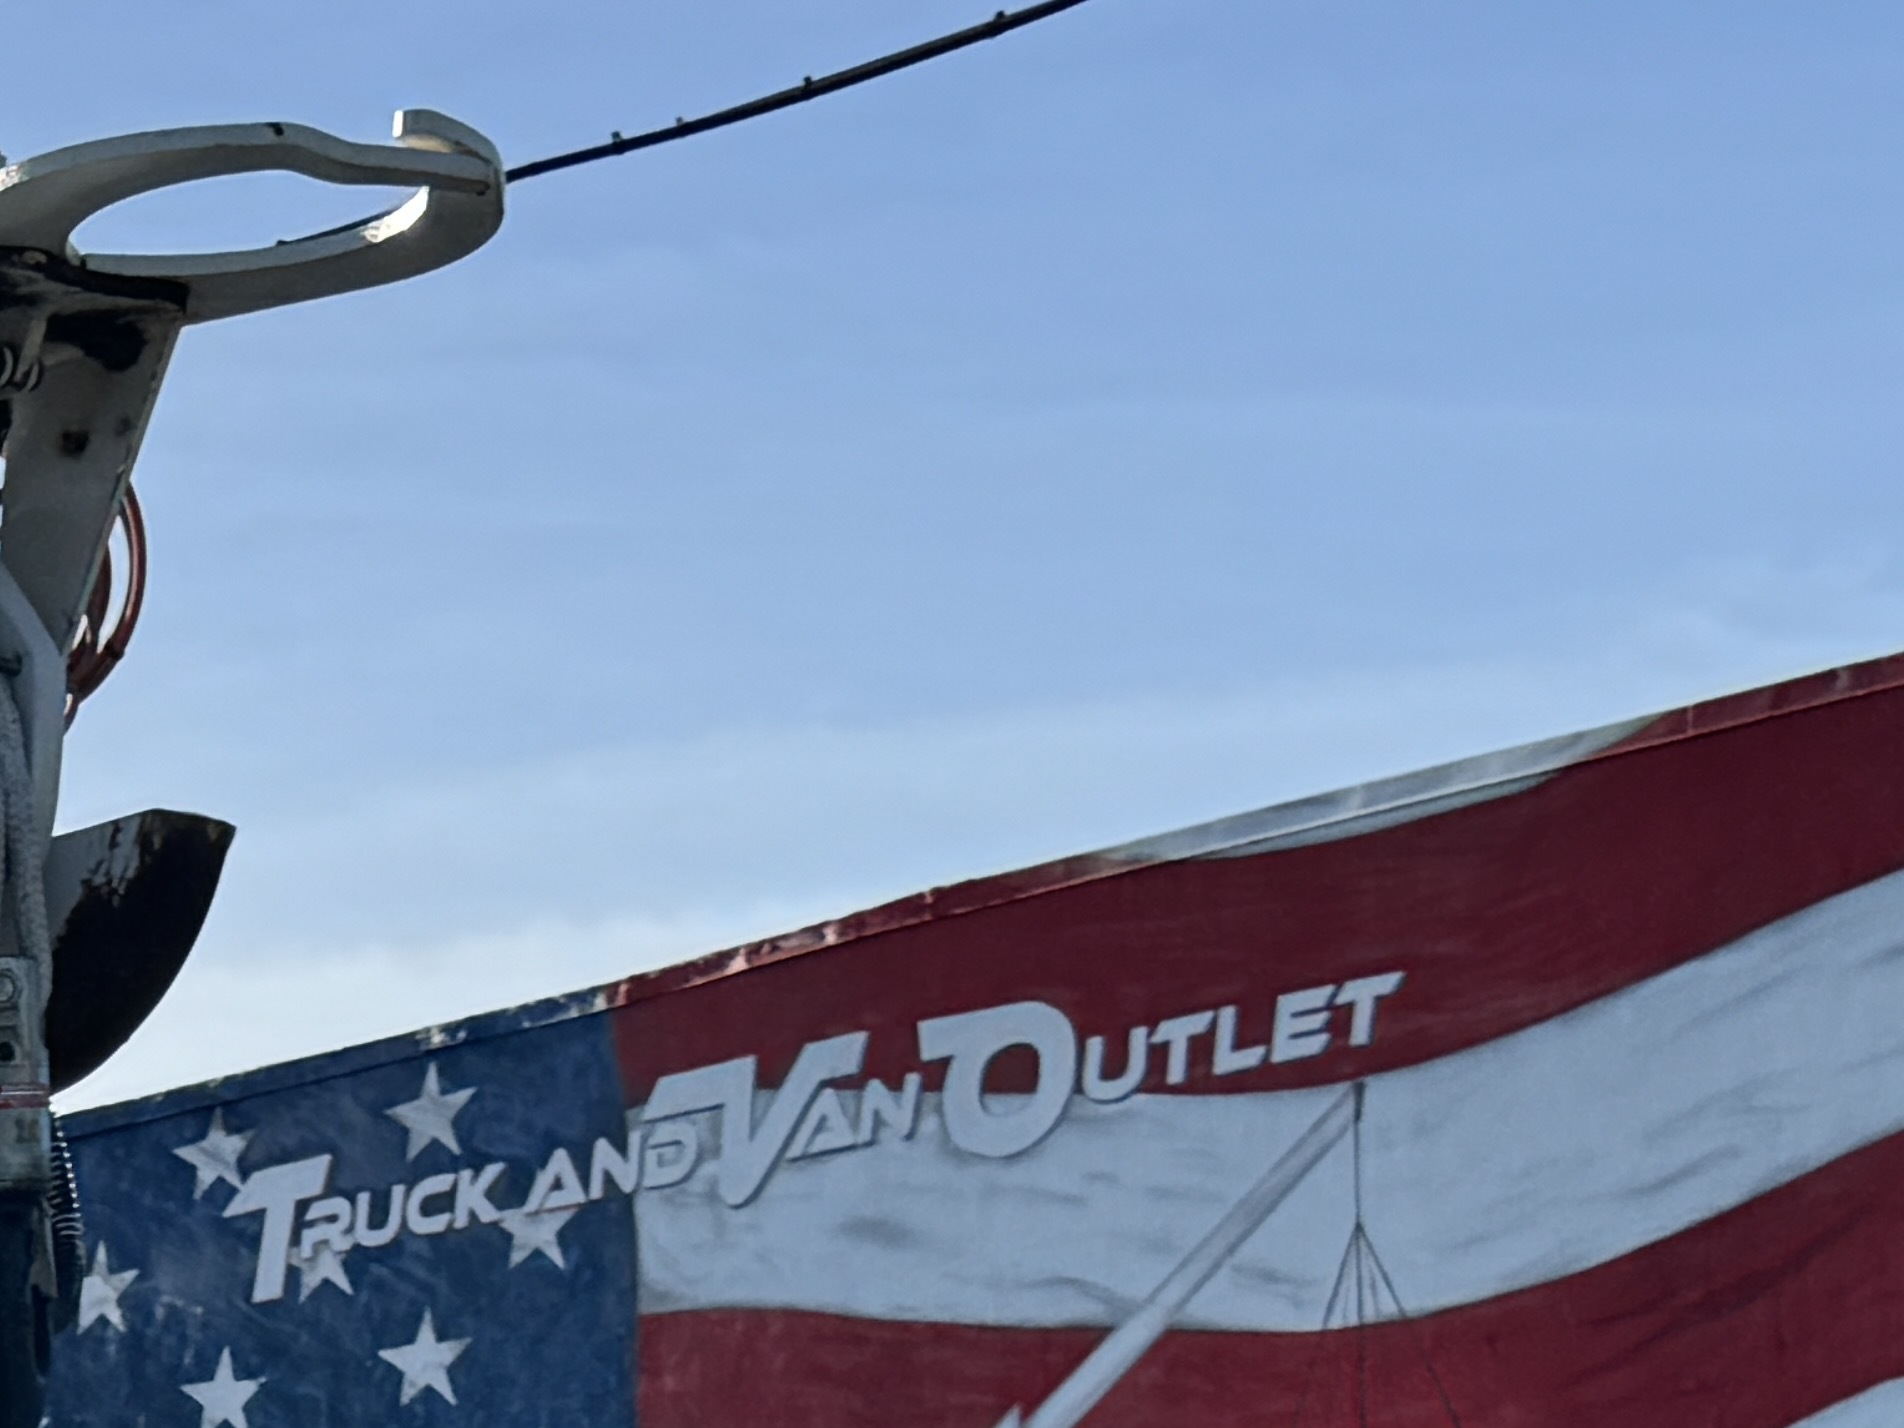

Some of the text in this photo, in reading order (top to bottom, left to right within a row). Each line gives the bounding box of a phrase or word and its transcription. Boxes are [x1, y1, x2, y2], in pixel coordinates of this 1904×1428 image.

[222, 970, 1406, 1304] TRUCK AND VAN OUTLET
